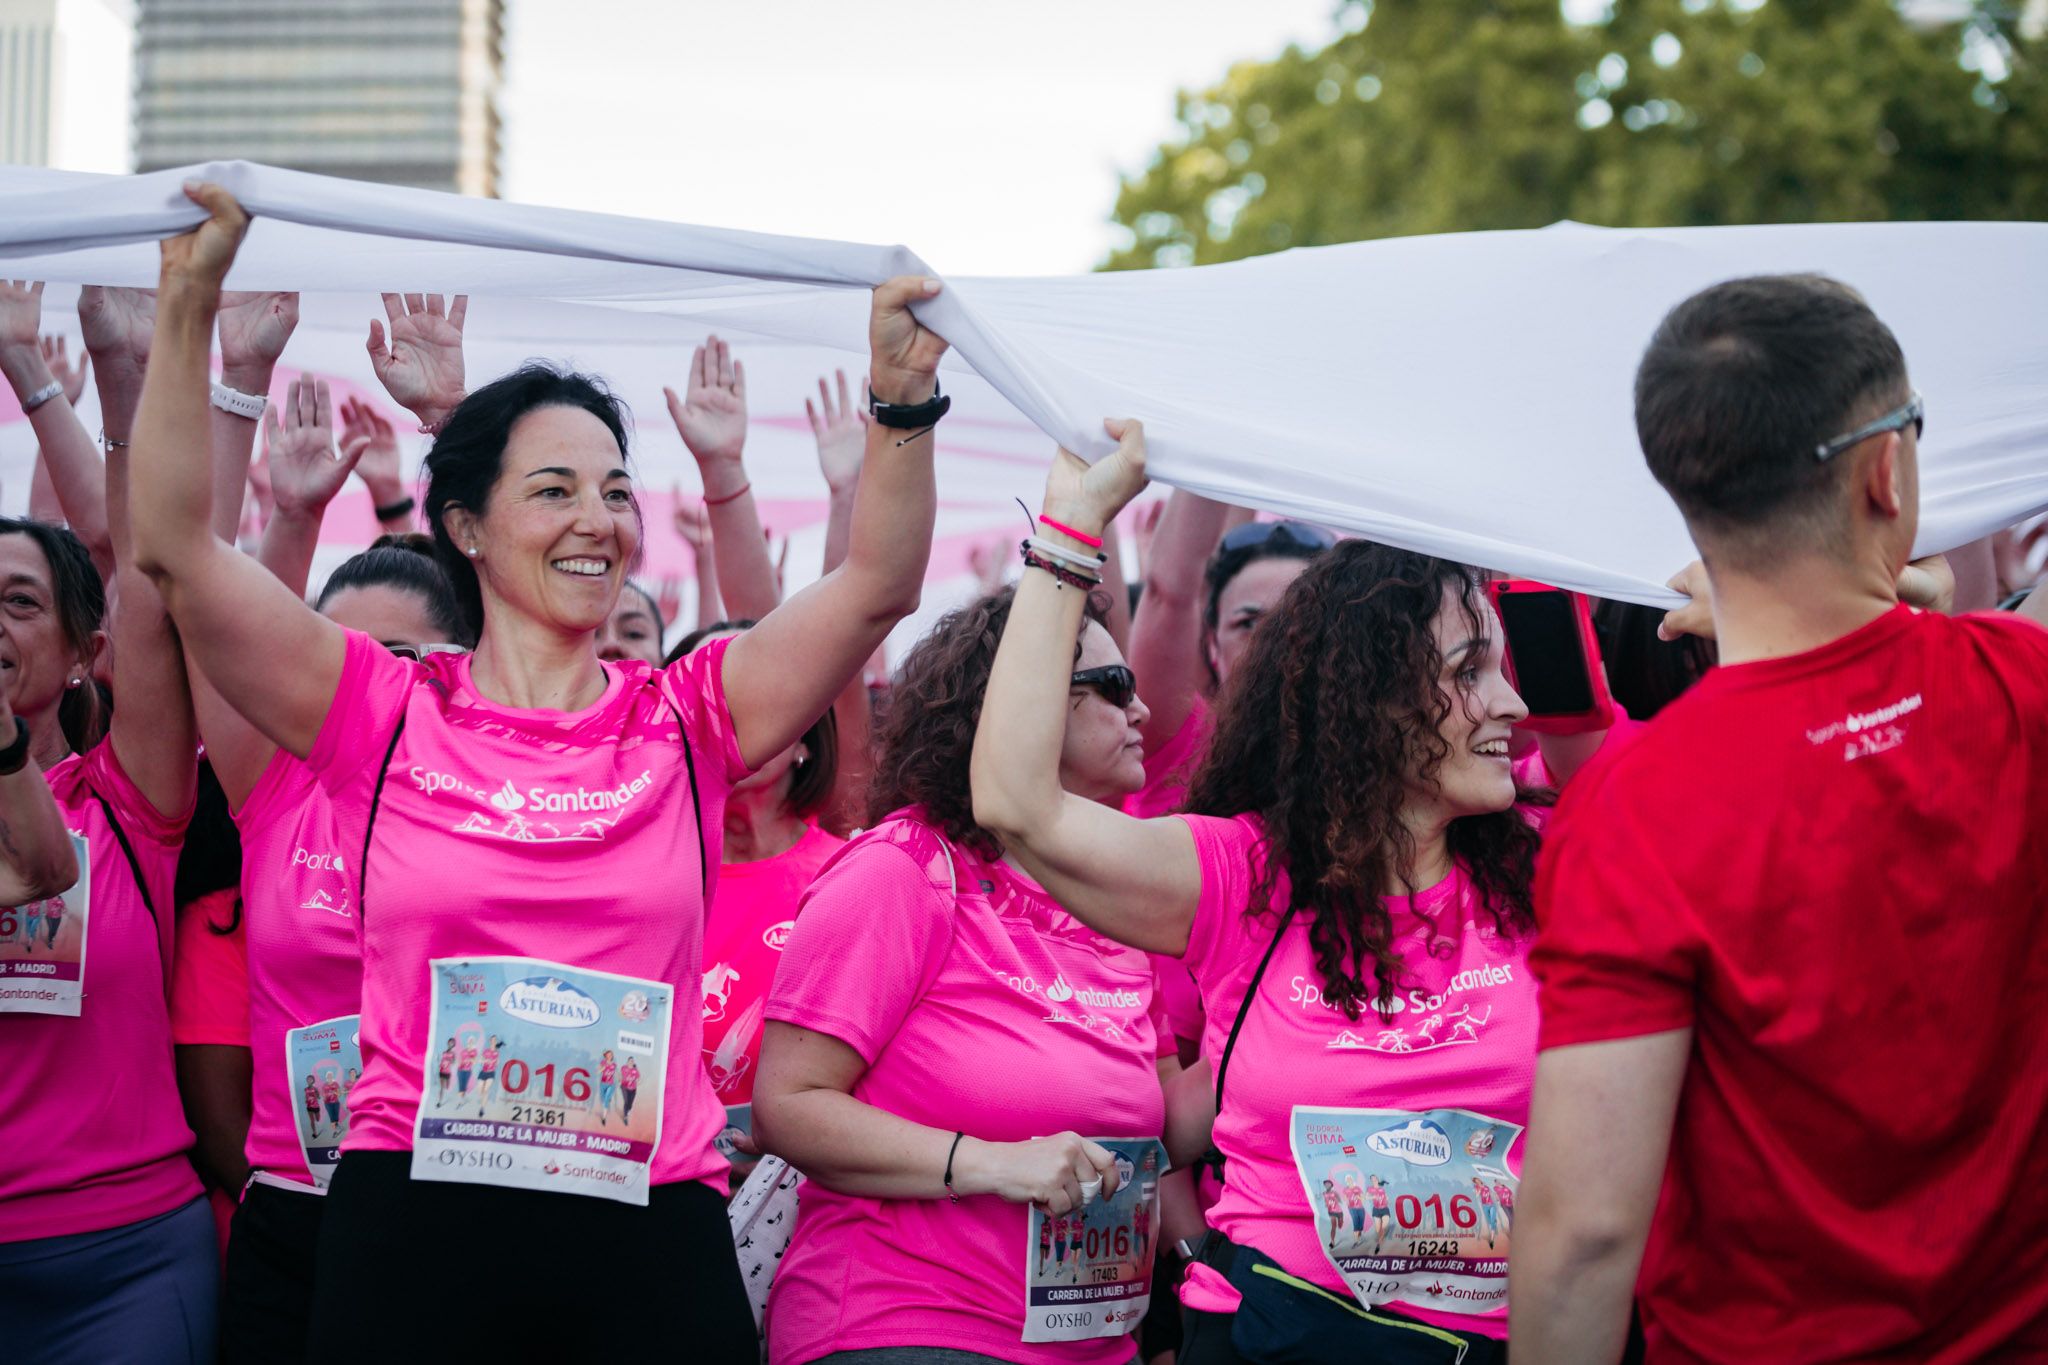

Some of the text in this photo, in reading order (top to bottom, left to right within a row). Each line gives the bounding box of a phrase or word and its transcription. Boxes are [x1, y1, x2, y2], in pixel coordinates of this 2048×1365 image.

[528, 769, 653, 812] Santander
[14, 963, 57, 974] MADRID
[504, 991, 593, 1022] ASTURIANA
[1074, 987, 1142, 1008] antander
[500, 1059, 592, 1102] 016
[511, 1106, 565, 1126] 21361
[443, 1122, 632, 1155] CARRERA DE LA MUJER MADRID
[1306, 1132, 1346, 1145] SUMA
[1376, 1135, 1447, 1160] ASTURIANA
[438, 1148, 628, 1185] OYSHO Santander
[1394, 1193, 1478, 1230] 016
[1086, 1225, 1129, 1259] 016
[1408, 1240, 1459, 1256] 16243
[1091, 1267, 1118, 1282] 17403
[1391, 1259, 1405, 1271] DE
[1409, 1259, 1422, 1271] LA
[1425, 1260, 1465, 1271] MUJER
[1474, 1261, 1509, 1274] MADR
[1047, 1288, 1083, 1301] CARRERA
[1085, 1288, 1094, 1299] DE
[1094, 1287, 1102, 1298] LA
[1103, 1285, 1125, 1297] MUJER
[1354, 1279, 1507, 1301] SHO Santande
[1045, 1311, 1092, 1329] OYSHO
